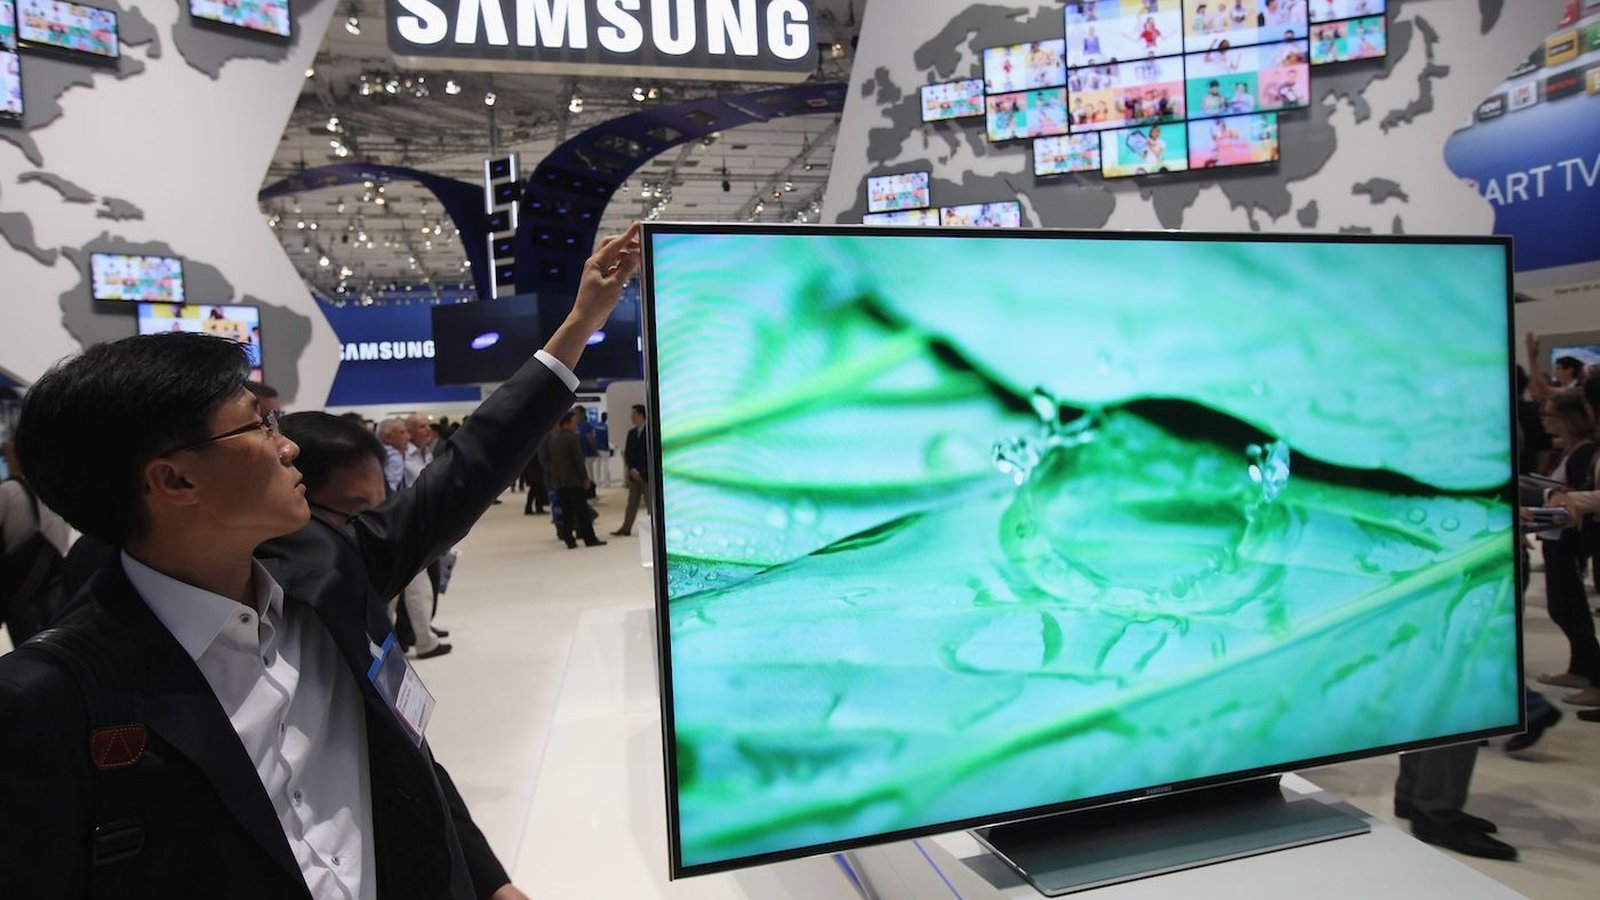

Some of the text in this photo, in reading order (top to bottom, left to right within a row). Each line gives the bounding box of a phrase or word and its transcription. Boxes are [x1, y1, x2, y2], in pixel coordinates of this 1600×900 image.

[397, 0, 810, 60] SAMSUNG
[1476, 153, 1600, 206] ART TV
